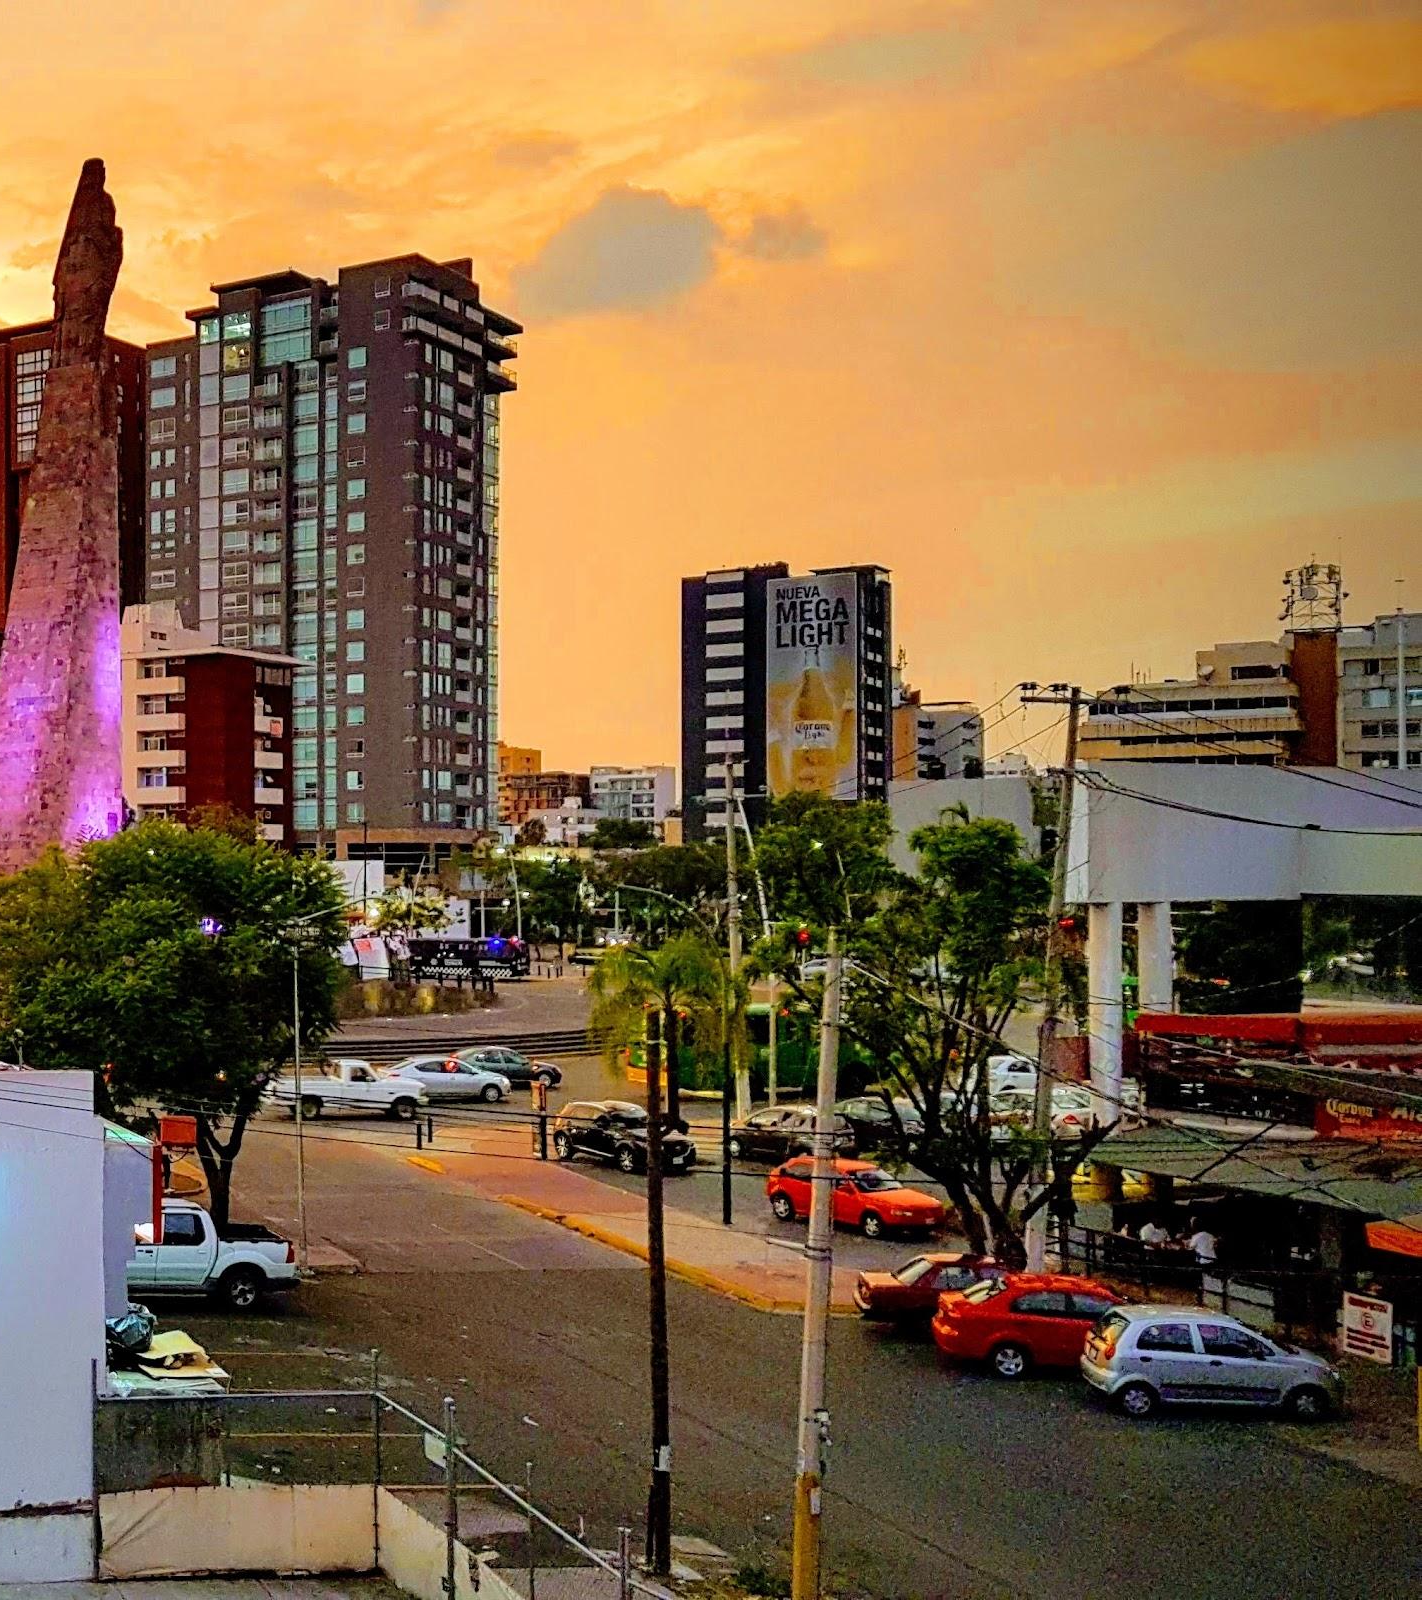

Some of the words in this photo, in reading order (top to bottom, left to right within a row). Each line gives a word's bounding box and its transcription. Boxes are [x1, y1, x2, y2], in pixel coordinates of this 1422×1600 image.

[776, 586, 820, 600] NUEVA
[776, 598, 849, 624] MEGA
[776, 621, 849, 648] LIGHT
[1326, 1098, 1374, 1118] Corona
